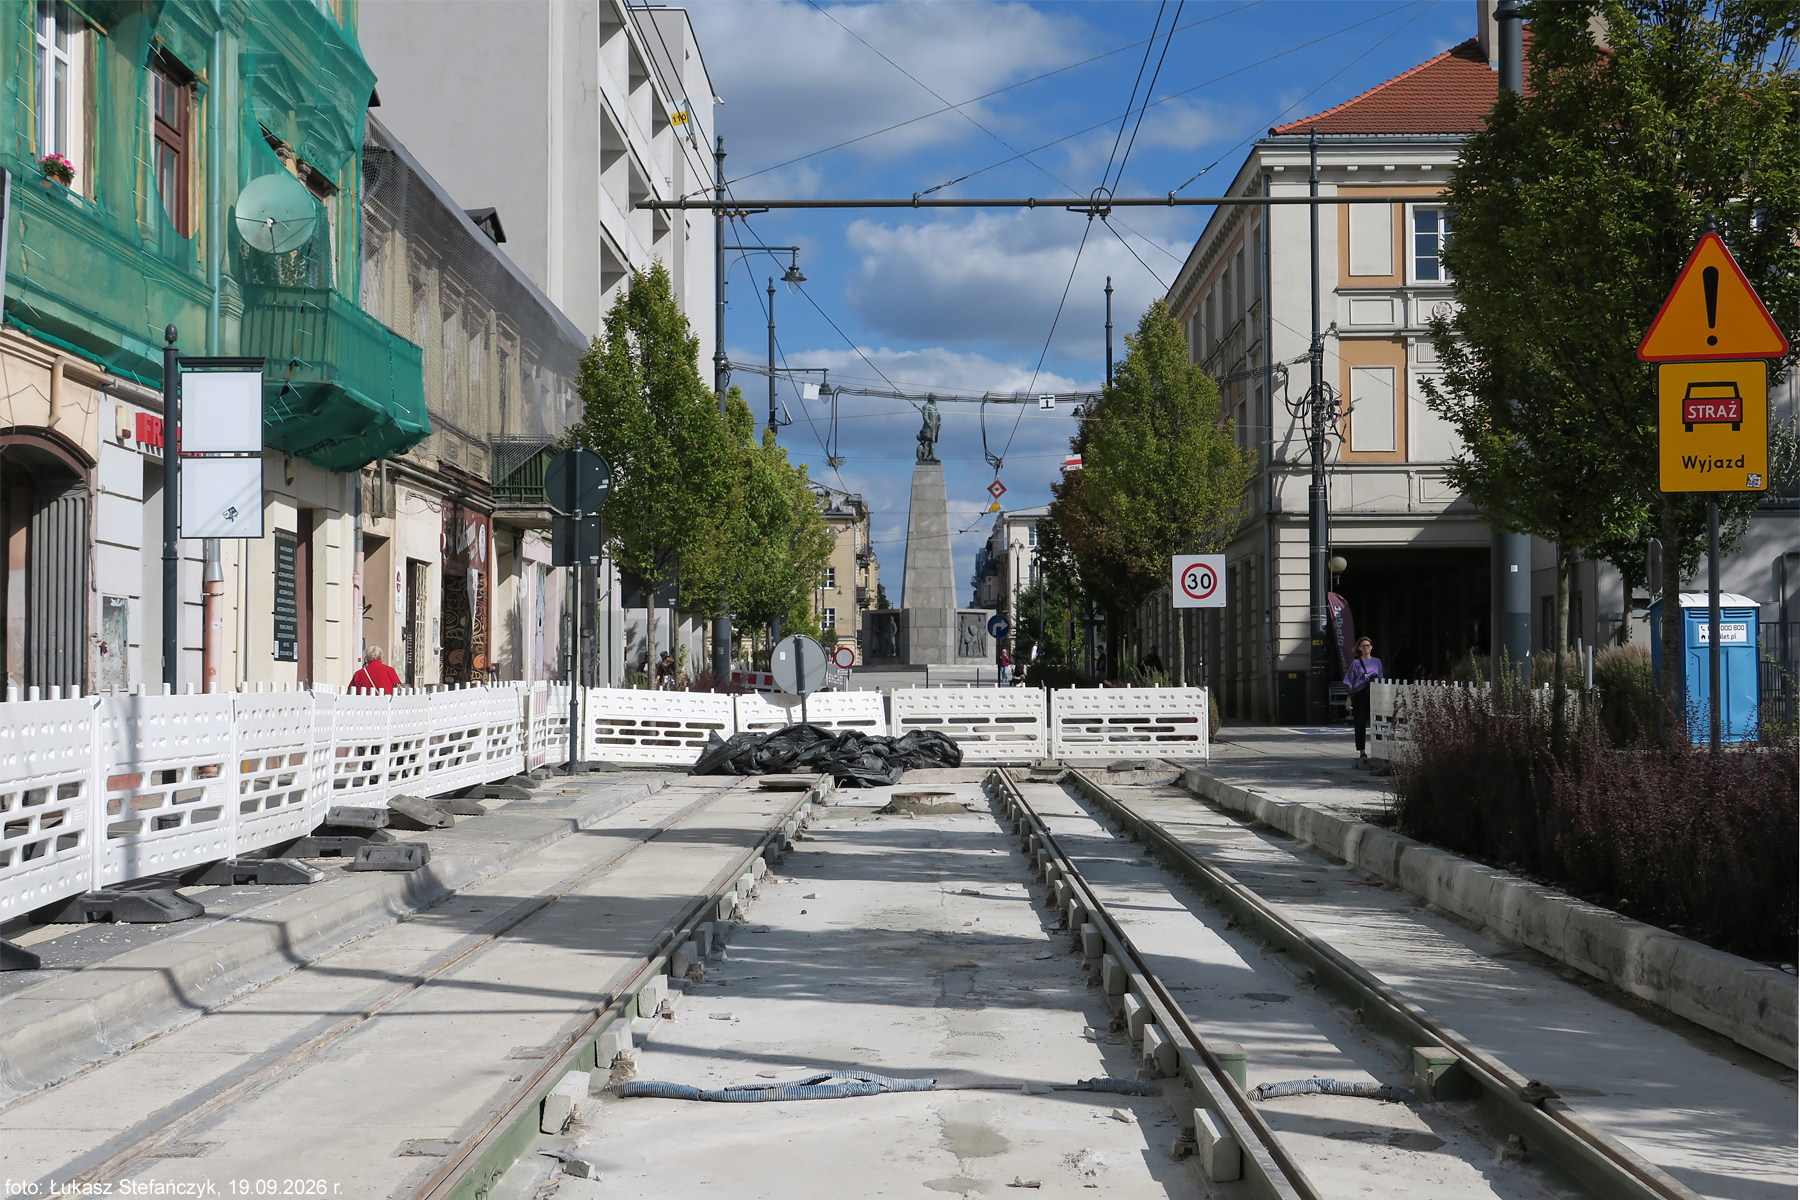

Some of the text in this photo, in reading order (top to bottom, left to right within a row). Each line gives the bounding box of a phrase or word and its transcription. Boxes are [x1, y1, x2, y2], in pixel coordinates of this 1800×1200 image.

[672, 113, 687, 123] 110
[1687, 401, 1737, 419] STRAŻ
[1681, 454, 1745, 473] Wyjazd
[1187, 573, 1212, 590] 30
